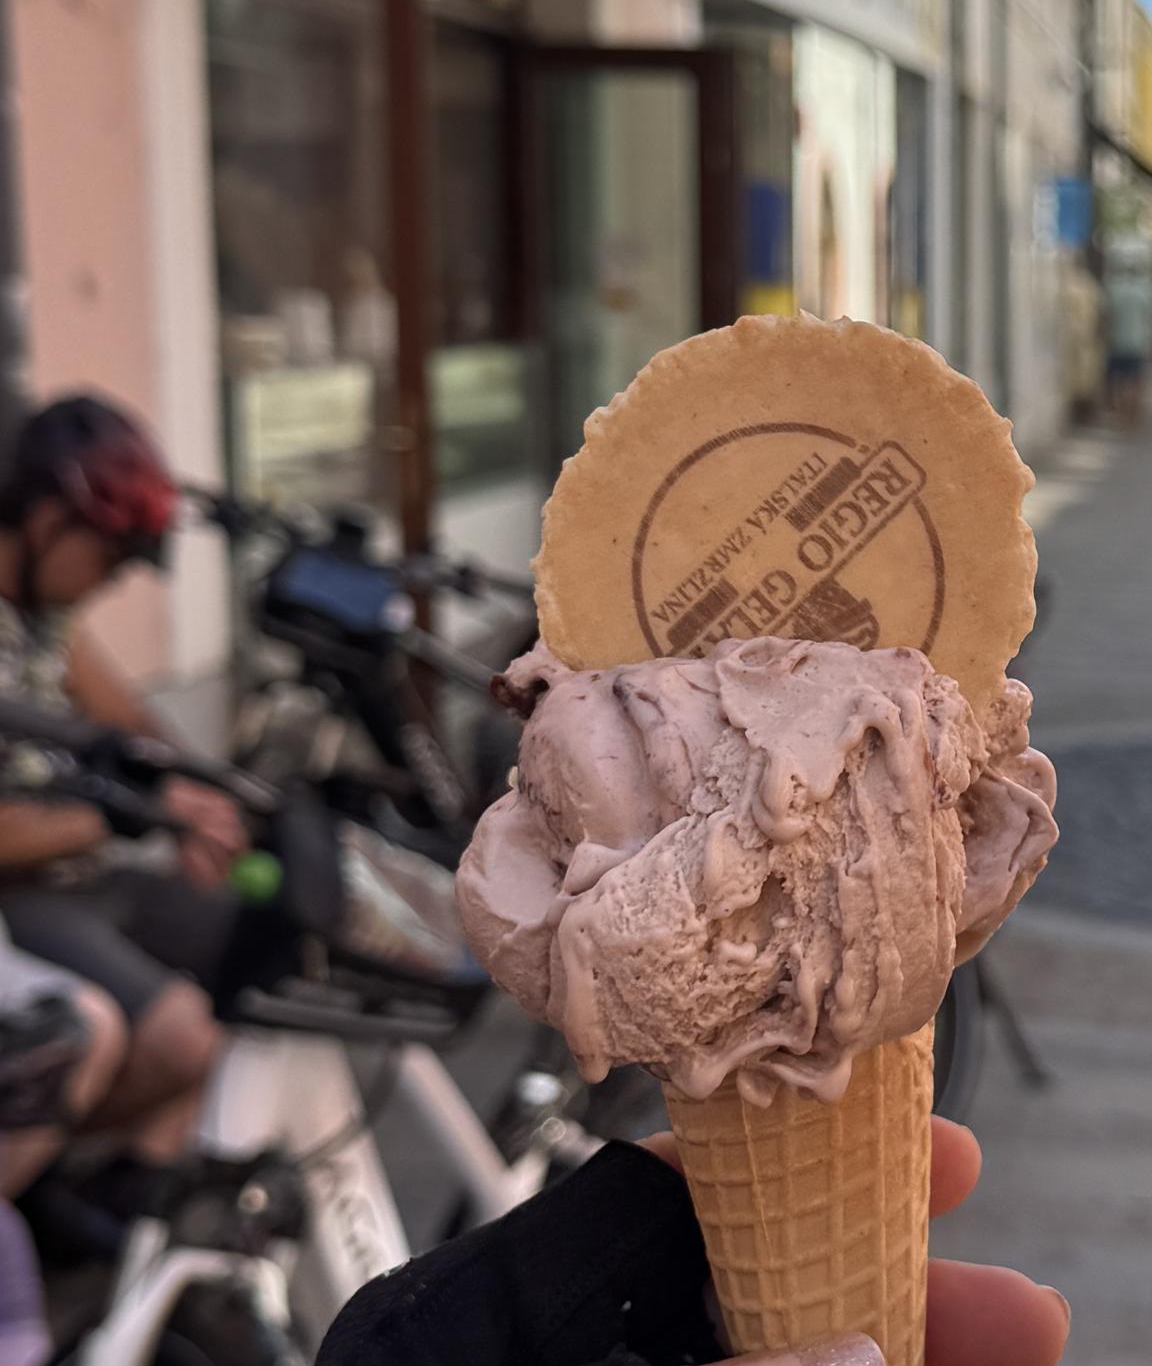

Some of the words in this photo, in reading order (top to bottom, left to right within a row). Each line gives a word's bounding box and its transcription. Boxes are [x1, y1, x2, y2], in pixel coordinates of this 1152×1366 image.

[746, 452, 828, 535] ITALSKÁ
[797, 458, 912, 572] REGIO
[651, 526, 752, 623] ZMRZLINA
[689, 570, 798, 658] GELA
